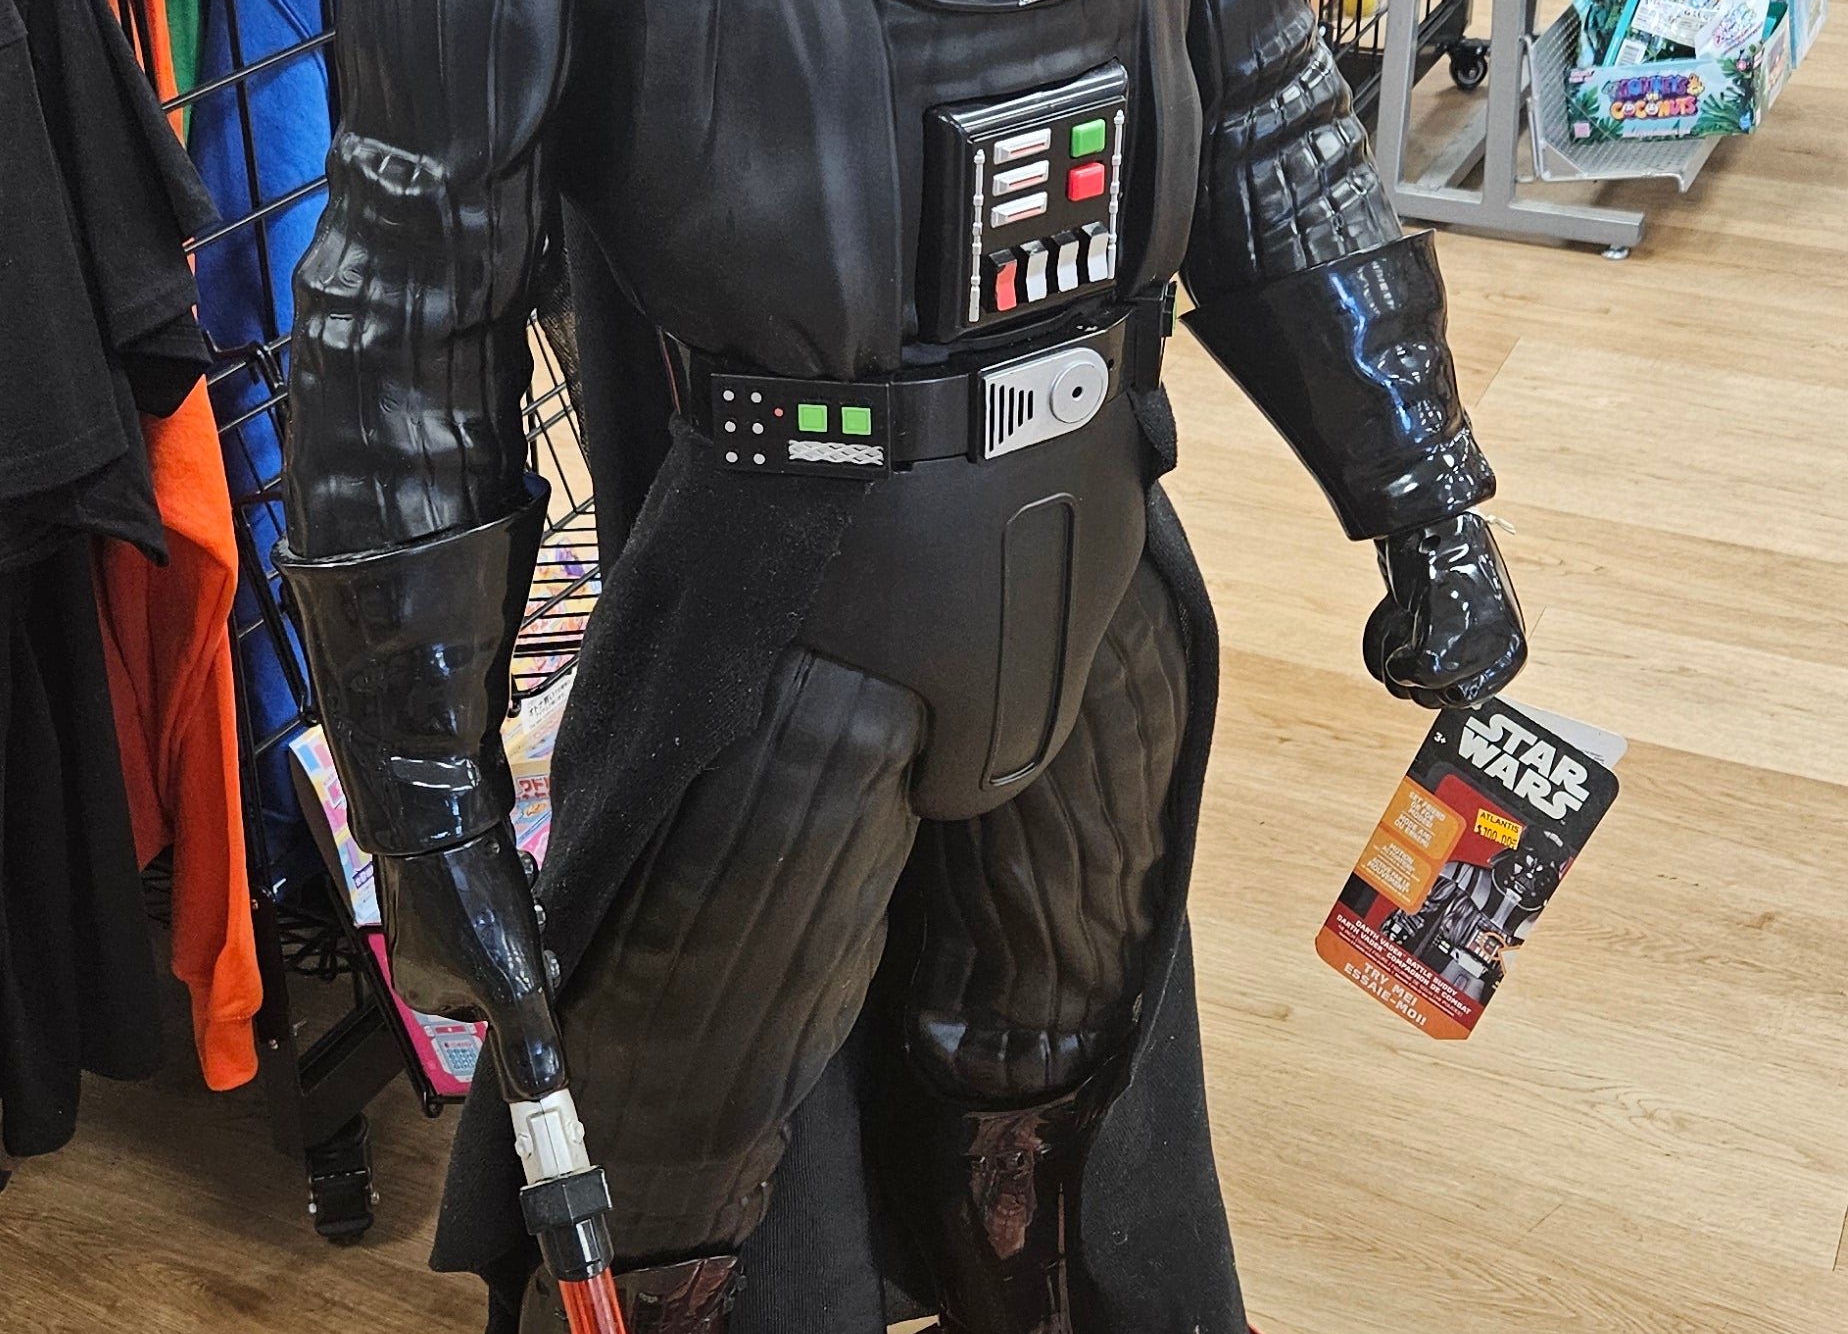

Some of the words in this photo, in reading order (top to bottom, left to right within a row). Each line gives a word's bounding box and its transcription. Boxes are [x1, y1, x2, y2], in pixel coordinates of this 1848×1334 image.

[1610, 96, 1697, 120] COCONUTS
[1433, 731, 1447, 744] 3+
[1465, 713, 1590, 802] STAR
[1458, 726, 1583, 820] WARS
[1480, 811, 1520, 834] ATLANTIS
[1335, 914, 1360, 933] DARTH
[1384, 952, 1430, 985] COMPAGNON
[1429, 984, 1440, 993] DE
[1440, 992, 1471, 1014] COMBAT
[1354, 920, 1380, 940] DARTH
[1405, 957, 1433, 978] BATTLE
[1432, 976, 1458, 995] BUDDY
[1362, 963, 1389, 985] TRY
[1391, 983, 1418, 1005] ME!
[1341, 963, 1429, 1024] ESSAIE-MOI!
